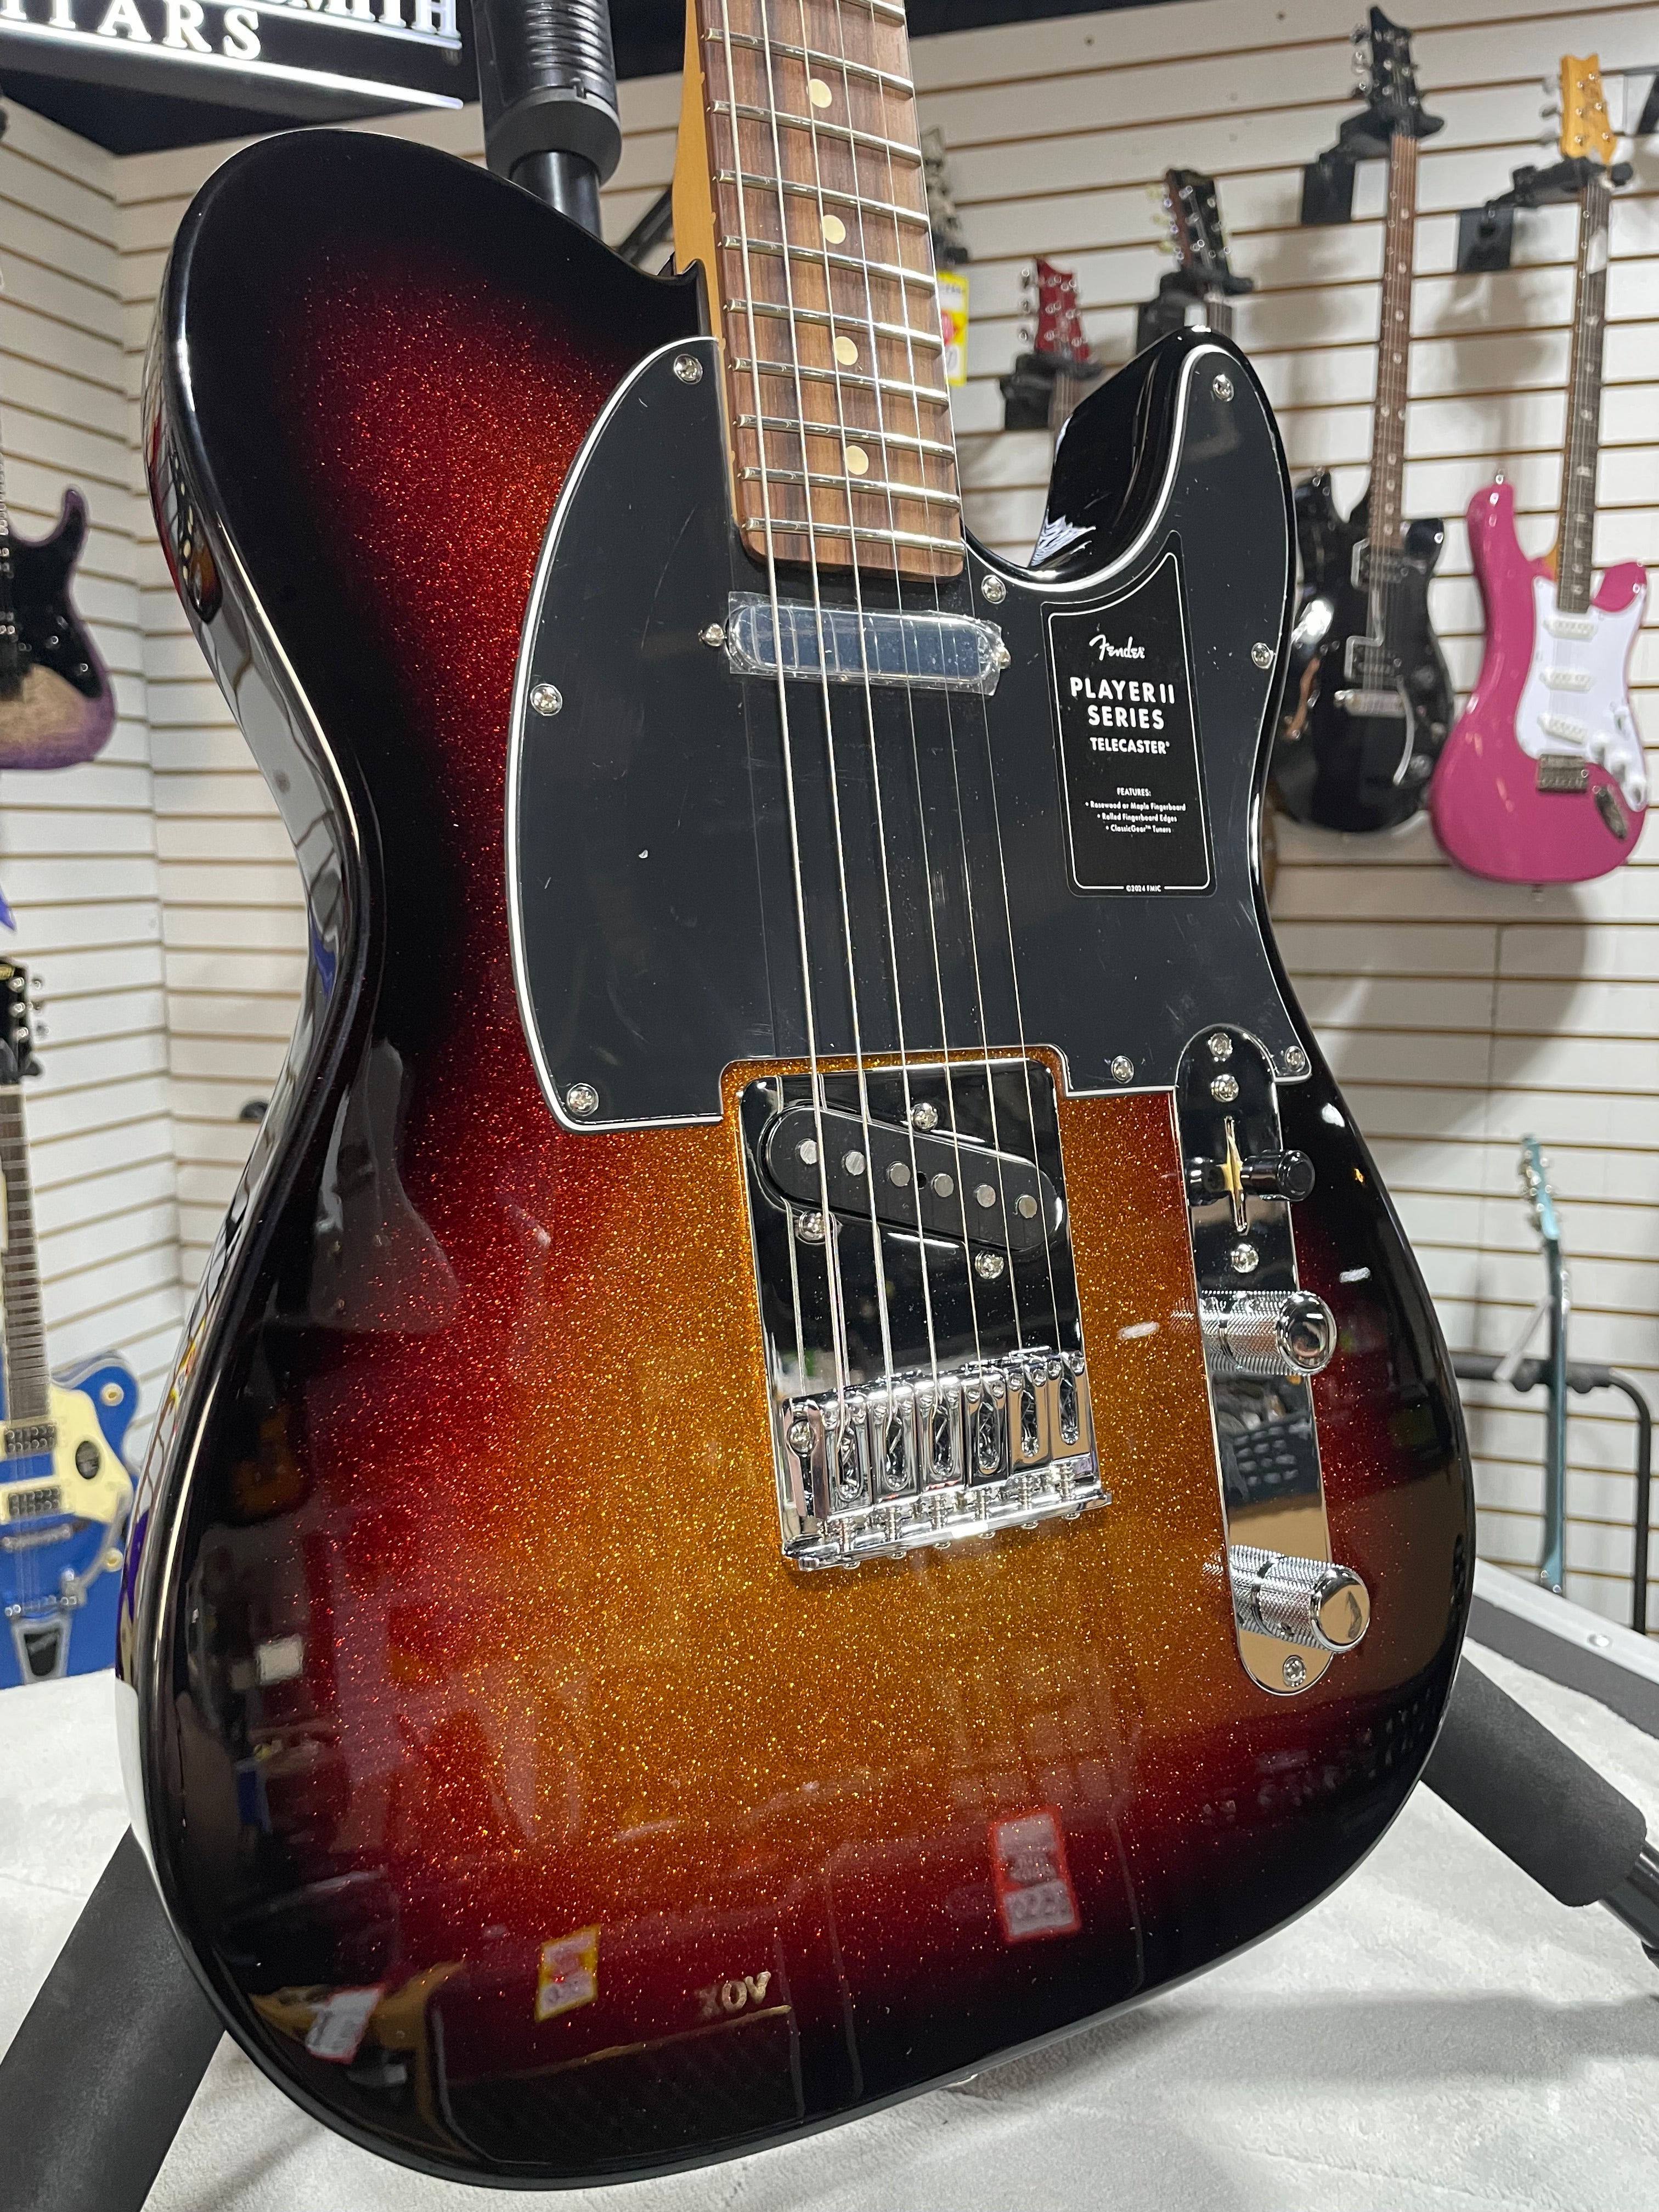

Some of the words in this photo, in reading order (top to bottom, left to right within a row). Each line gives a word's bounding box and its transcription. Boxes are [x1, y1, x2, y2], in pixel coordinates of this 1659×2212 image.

[0, 0, 260, 60] ARS
[1089, 635, 1146, 661] Fender
[1070, 677, 1156, 703] PLAYER
[1159, 684, 1175, 703] II
[1087, 705, 1165, 730] SERIES
[1117, 787, 1152, 797] FEATURES:
[1090, 800, 1121, 809] Rosewood
[1130, 802, 1149, 811] Maple
[1150, 803, 1186, 812] Fingerboard
[1102, 812, 1121, 821] Rolled
[1122, 814, 1159, 822] Fingerboard
[1160, 814, 1177, 823] Edges
[1153, 825, 1172, 833] Tuners
